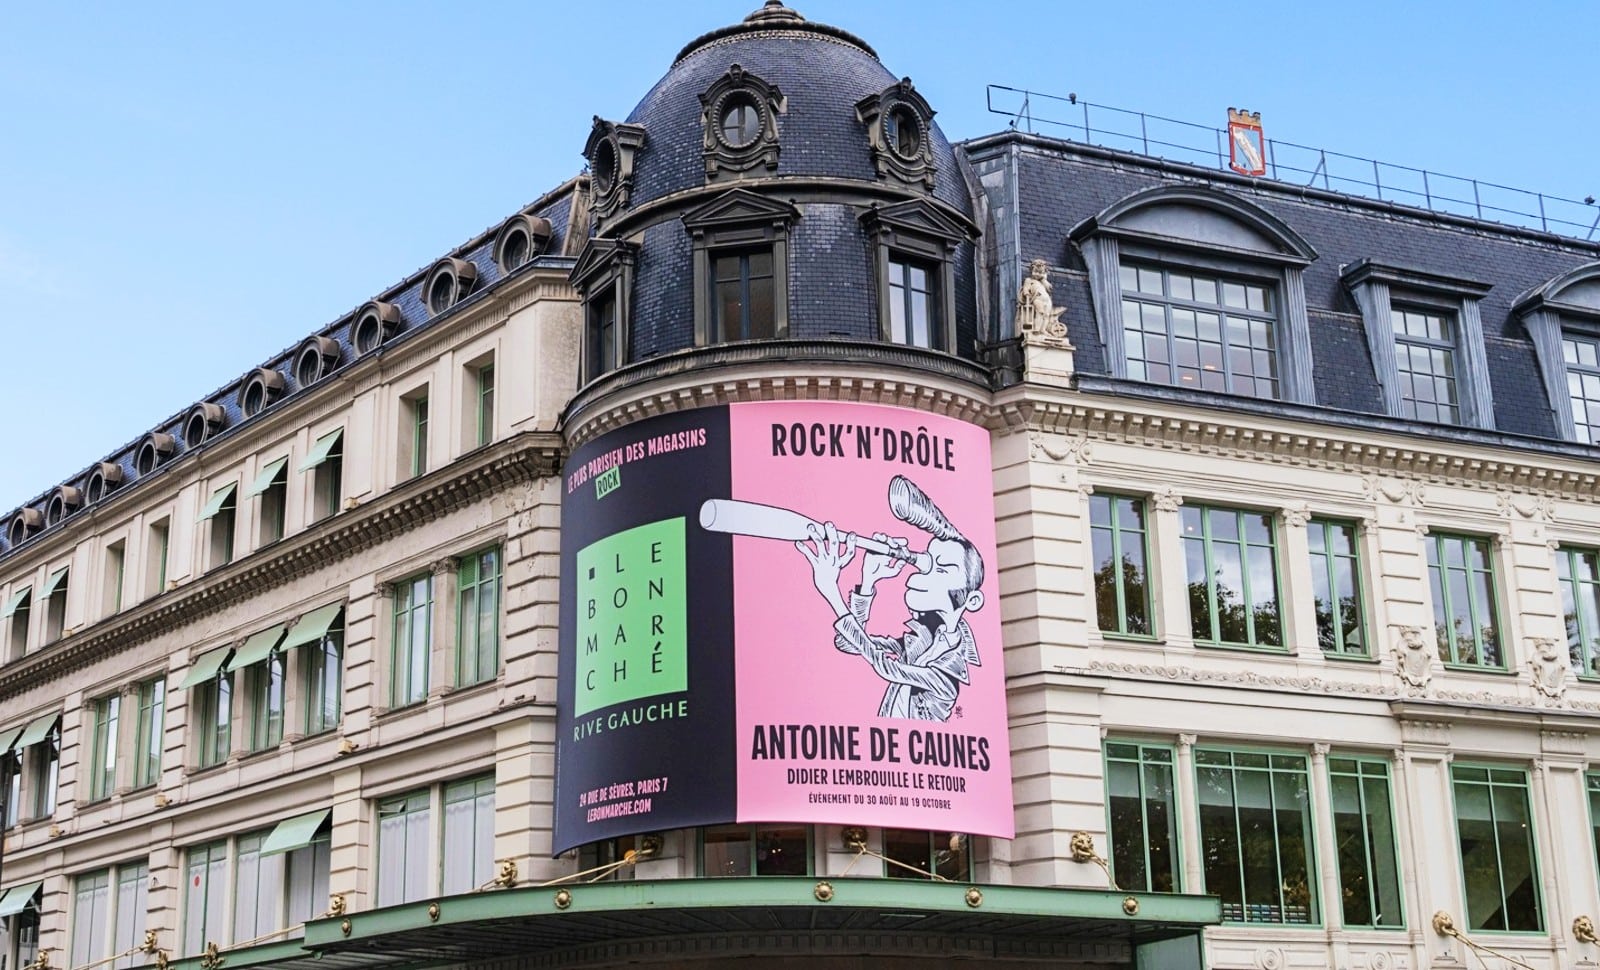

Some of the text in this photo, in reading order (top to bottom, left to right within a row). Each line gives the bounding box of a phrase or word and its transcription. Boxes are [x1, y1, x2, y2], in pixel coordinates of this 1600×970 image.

[568, 427, 707, 494] LE PLUS PARISIEN DES MAGASINS
[771, 422, 956, 472] ROCK'N'DRÔLE
[596, 469, 619, 496] ROCK
[573, 700, 688, 742] RIVE GAUCHE
[751, 724, 990, 772] ANTOINE DE CAUNES
[588, 788, 599, 805] RUE
[600, 786, 608, 801] DE
[638, 778, 661, 796] PARIS
[662, 777, 668, 792] 7
[787, 768, 966, 793] DIDIER LEMBROUILLE LE RETOUR
[587, 798, 652, 823] LEBONMARCHE.COM
[854, 794, 864, 805] DU
[867, 795, 877, 805] 30
[879, 794, 897, 806] AOÛT
[900, 797, 909, 807] AU
[911, 798, 920, 808] 19
[922, 798, 952, 810] OCTOBRE
